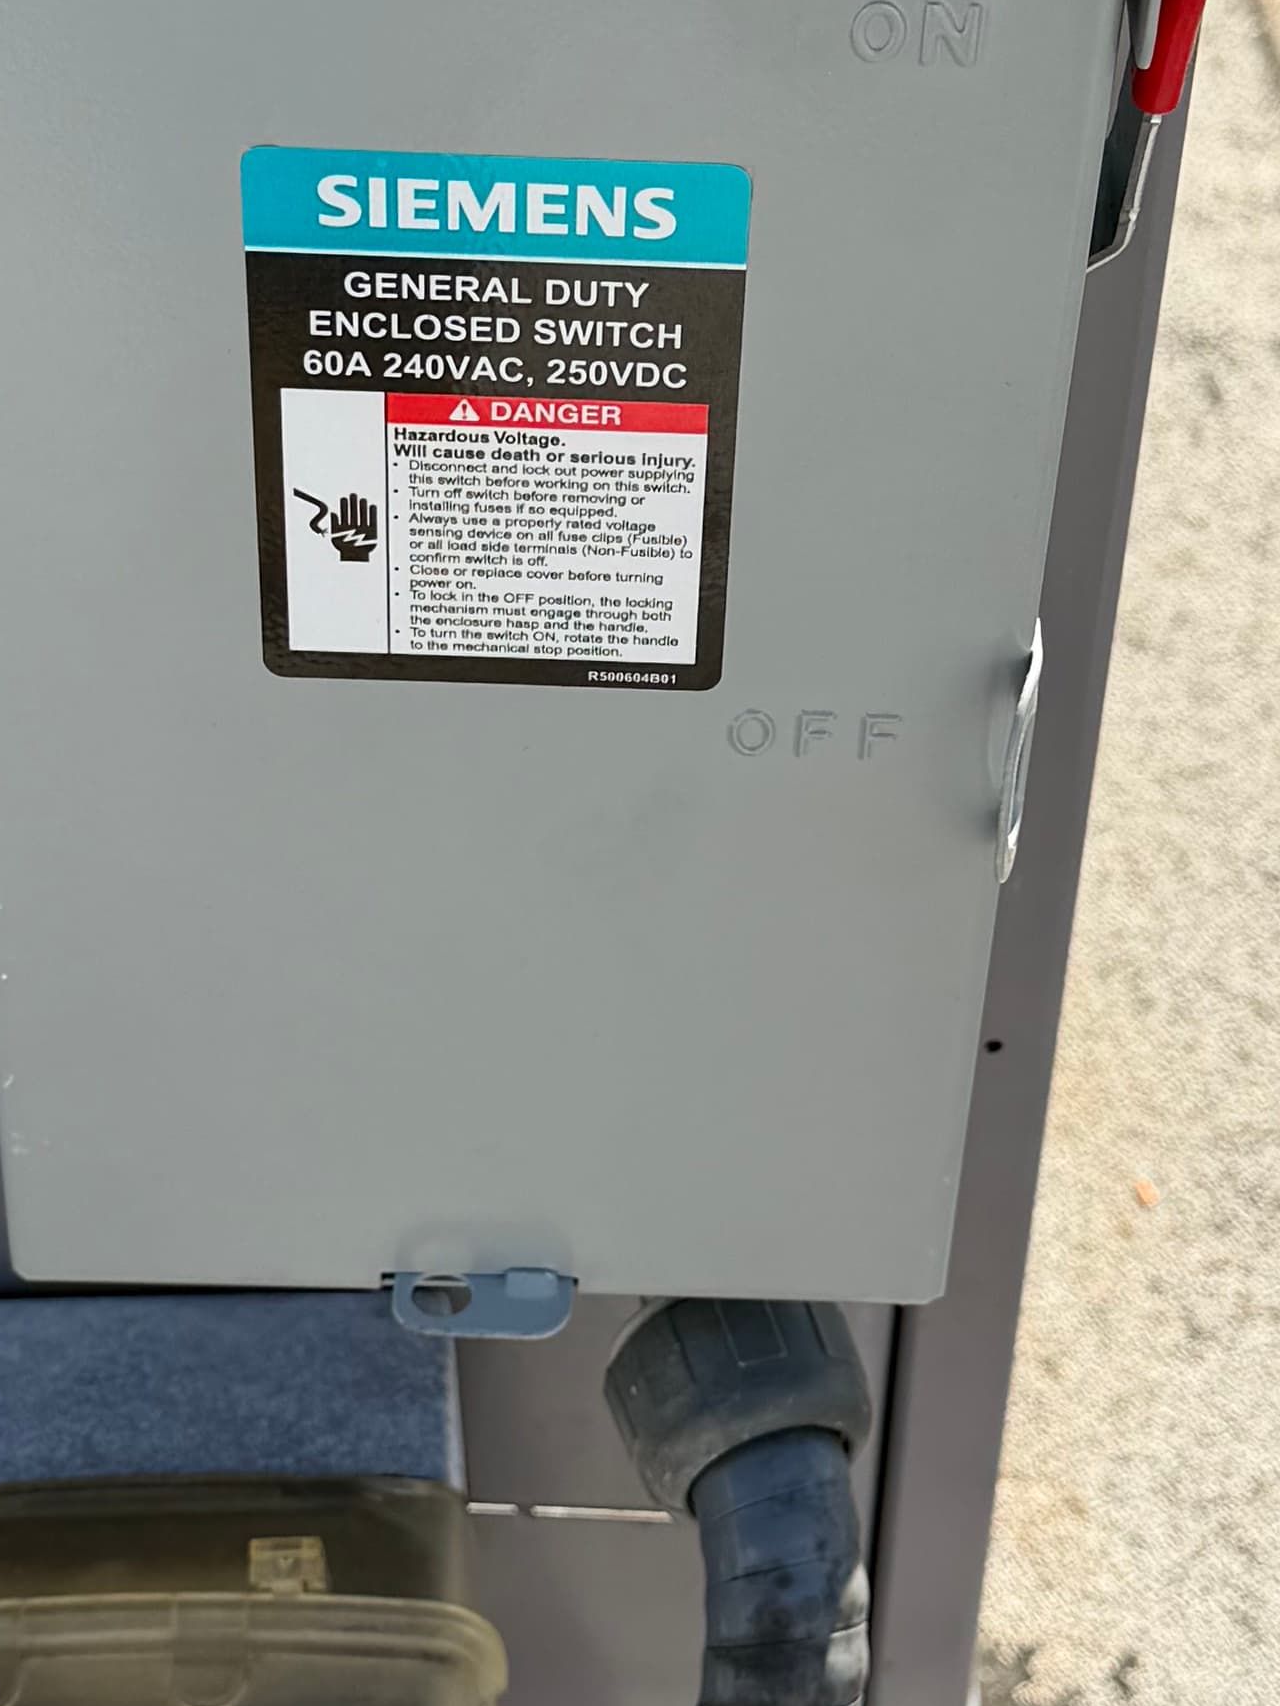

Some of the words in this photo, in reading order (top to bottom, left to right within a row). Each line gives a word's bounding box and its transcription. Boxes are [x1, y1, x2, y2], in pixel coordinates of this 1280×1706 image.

[316, 174, 677, 240] SIEMENS
[343, 271, 532, 306] GENERAL
[546, 278, 650, 309] DUTY
[308, 310, 521, 344] ENCLOSED
[533, 317, 683, 349] SWITCH
[303, 350, 371, 378] 60A
[383, 353, 534, 387] 240VAC,
[547, 359, 687, 389] 250VDC
[490, 400, 621, 426] DANGER
[394, 427, 490, 443] Hazardous
[494, 431, 566, 448] Voltage.
[394, 444, 427, 458] Will
[432, 448, 485, 460] cause
[491, 448, 540, 462] death
[546, 452, 565, 463] or
[570, 451, 636, 465] serious
[642, 453, 696, 470] injury.
[409, 460, 487, 473] Disconnect
[491, 463, 518, 474] and
[522, 464, 550, 476] lock
[554, 466, 576, 476] out
[580, 467, 624, 479] power
[628, 468, 695, 483] supplying
[409, 473, 433, 484] this
[438, 475, 480, 486] switch
[485, 476, 530, 488] before
[534, 478, 588, 492] working
[593, 482, 610, 491] on
[615, 481, 640, 492] this
[643, 482, 690, 494] switch.
[408, 486, 440, 497] Turn
[444, 488, 462, 498] off
[465, 488, 509, 501] switch
[514, 490, 557, 502] before
[562, 493, 626, 507] removing
[630, 495, 645, 505] or
[409, 500, 470, 514] installing
[474, 502, 511, 514] fuses
[516, 503, 526, 514] if
[528, 506, 545, 515] so
[549, 505, 617, 518] equipped.
[408, 513, 458, 526] Always
[462, 517, 487, 526] use
[492, 518, 500, 526] a
[505, 517, 562, 530] properly
[566, 518, 601, 530] rated
[605, 520, 656, 534] voltage
[409, 527, 463, 541] sensing
[467, 528, 512, 540] device
[516, 532, 533, 541] on
[538, 531, 553, 542] all
[558, 531, 587, 543] fuse
[591, 532, 623, 545] clips
[627, 533, 687, 548] (Fusible)
[409, 541, 423, 550] or
[428, 540, 442, 550] all
[447, 540, 476, 552] load
[481, 541, 509, 552] side
[514, 543, 577, 555] terminals
[581, 544, 675, 561] (Non-Fusible)
[680, 549, 693, 559] to
[409, 552, 460, 564] confirm
[465, 554, 507, 566] switch
[512, 555, 523, 566] is
[527, 555, 548, 567] off.
[409, 564, 449, 576] Close
[453, 567, 467, 577] or
[471, 567, 522, 579] replace
[526, 571, 564, 580] cover
[569, 570, 611, 582] before
[615, 572, 663, 586] turning
[409, 578, 451, 591] power
[456, 580, 476, 590] on.
[409, 590, 426, 601] To
[430, 590, 456, 602] lock
[462, 592, 473, 602] in
[478, 592, 499, 603] the
[503, 593, 534, 604] OFF
[538, 594, 595, 607] position,
[600, 597, 620, 607] the
[625, 597, 673, 611] locking
[410, 602, 488, 615] mechanism
[493, 605, 526, 616] must
[530, 609, 581, 620] engage
[585, 609, 637, 622] through
[641, 610, 672, 621] both
[410, 615, 431, 626] the
[435, 616, 502, 628] enclosure
[506, 619, 539, 631] hasp
[543, 619, 569, 630] and
[573, 620, 594, 631] the
[599, 621, 648, 633] handle.
[410, 626, 426, 638] To
[430, 628, 457, 639] turn
[462, 628, 482, 639] the
[487, 630, 528, 641] switch
[533, 631, 559, 644] ON,
[564, 633, 603, 644] rotate
[607, 634, 629, 645] the
[633, 635, 679, 647] handle
[410, 640, 423, 650] to
[427, 640, 448, 651] the
[453, 642, 529, 654] mechanical
[533, 644, 563, 657] stop
[567, 645, 622, 657] position.
[727, 708, 902, 761] OFF
